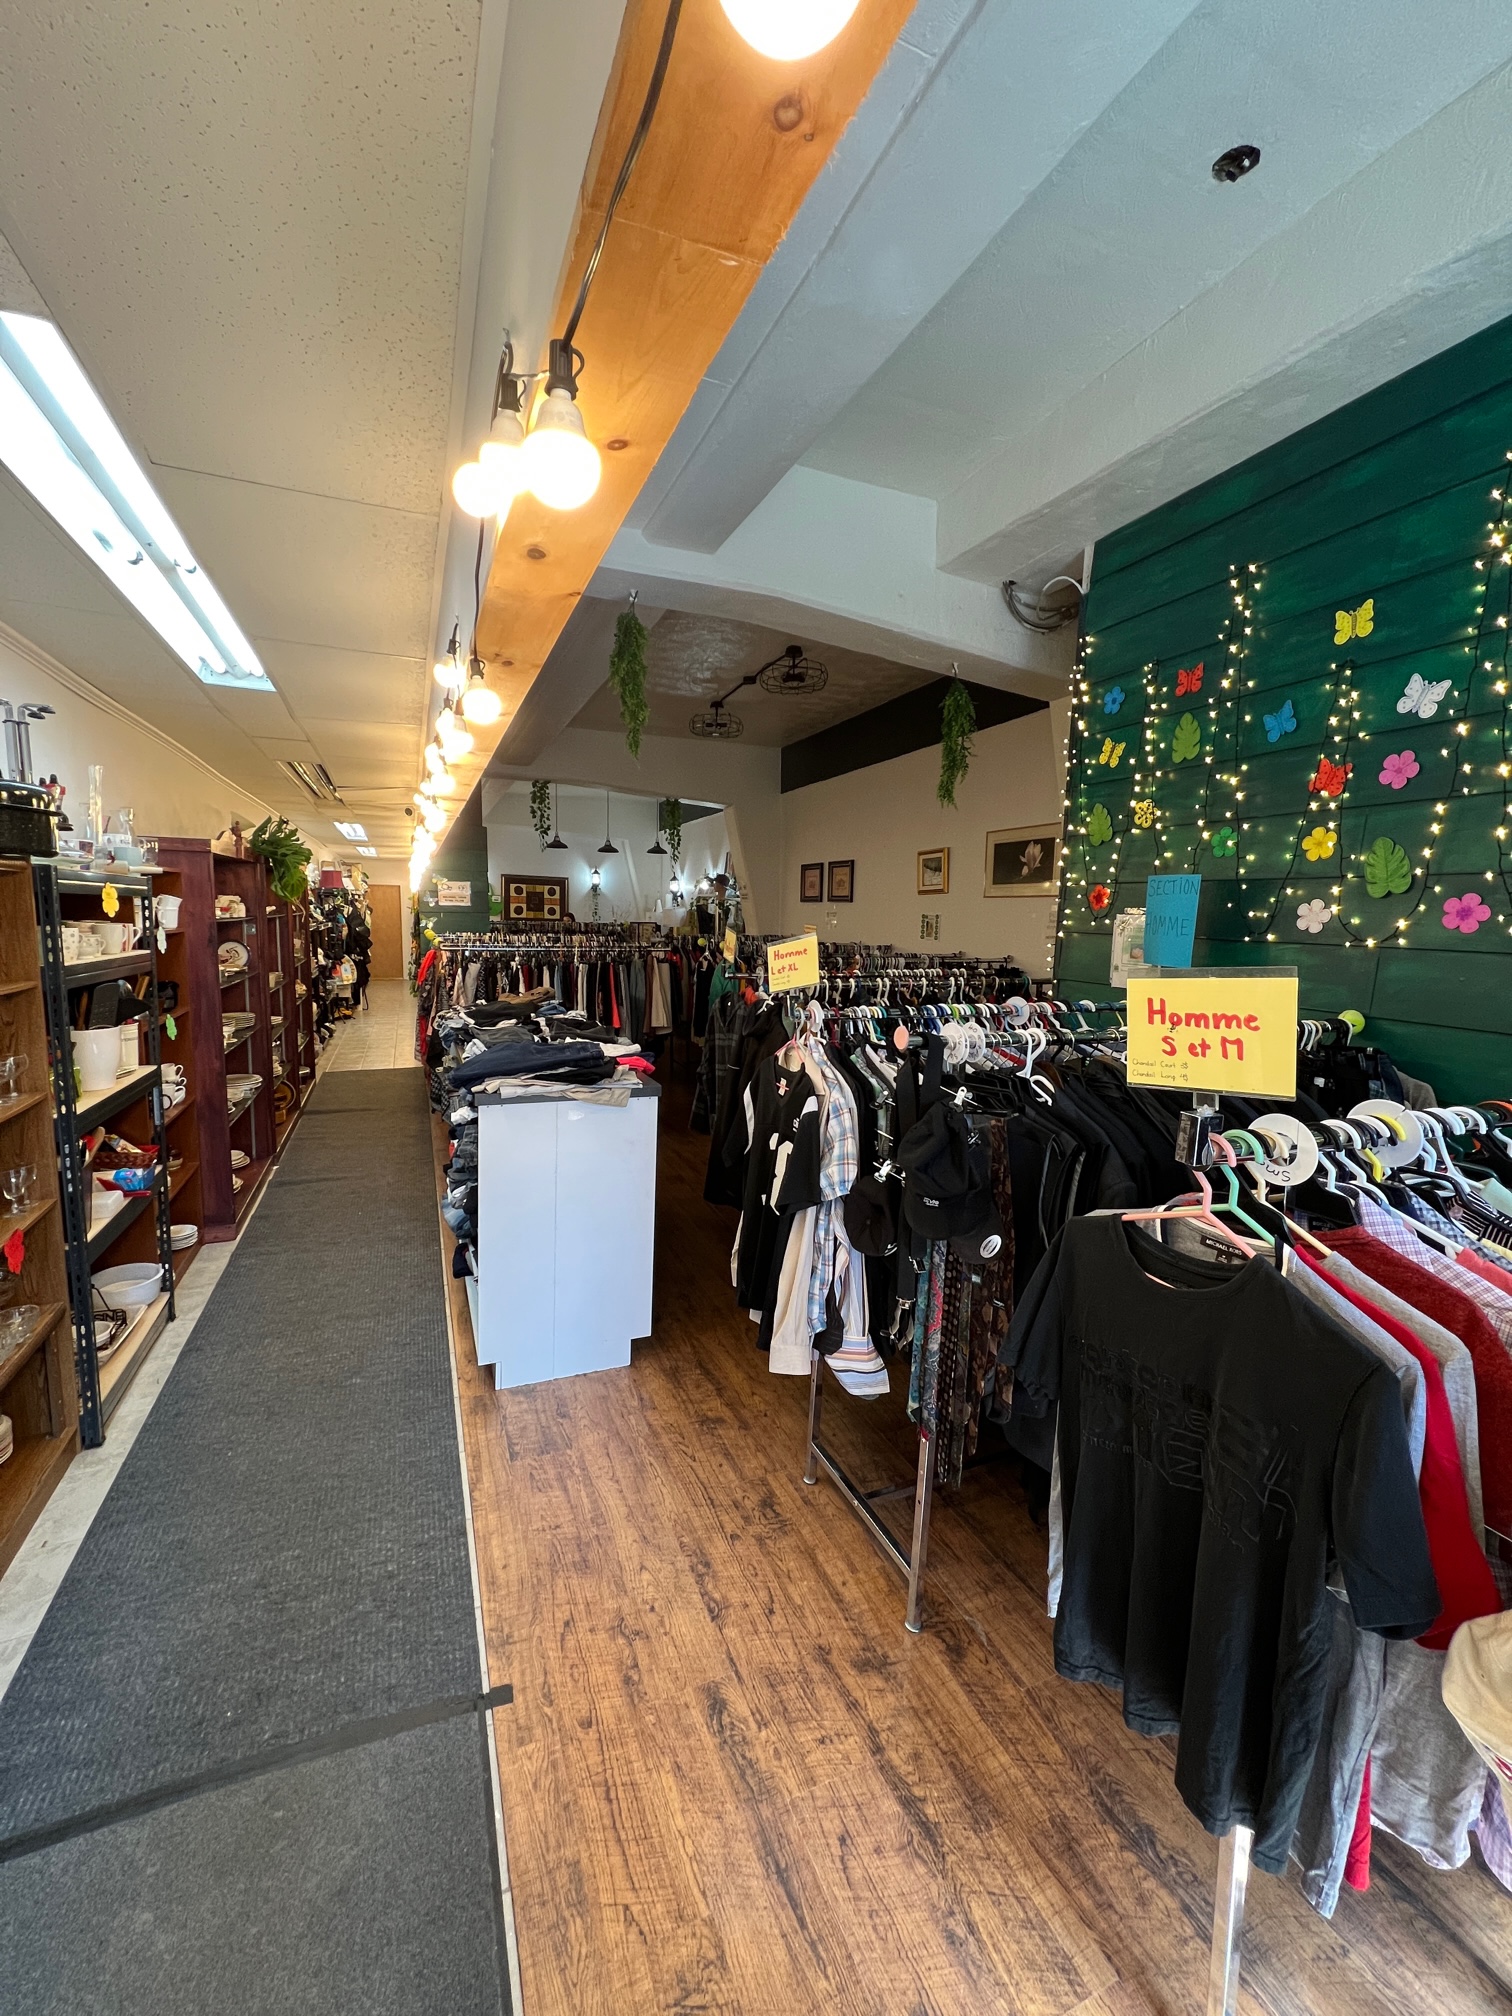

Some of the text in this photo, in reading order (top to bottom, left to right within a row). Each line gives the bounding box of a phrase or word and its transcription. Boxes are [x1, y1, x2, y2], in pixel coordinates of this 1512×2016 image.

[1148, 877, 1199, 897] SECTION
[773, 948, 808, 961] Homme
[771, 962, 799, 975] L et XL
[1147, 997, 1261, 1032] Homme
[1161, 1035, 1244, 1061] S et M
[1161, 1071, 1176, 1081] Long
[1206, 1239, 1242, 1256] MICHAEL KORS
